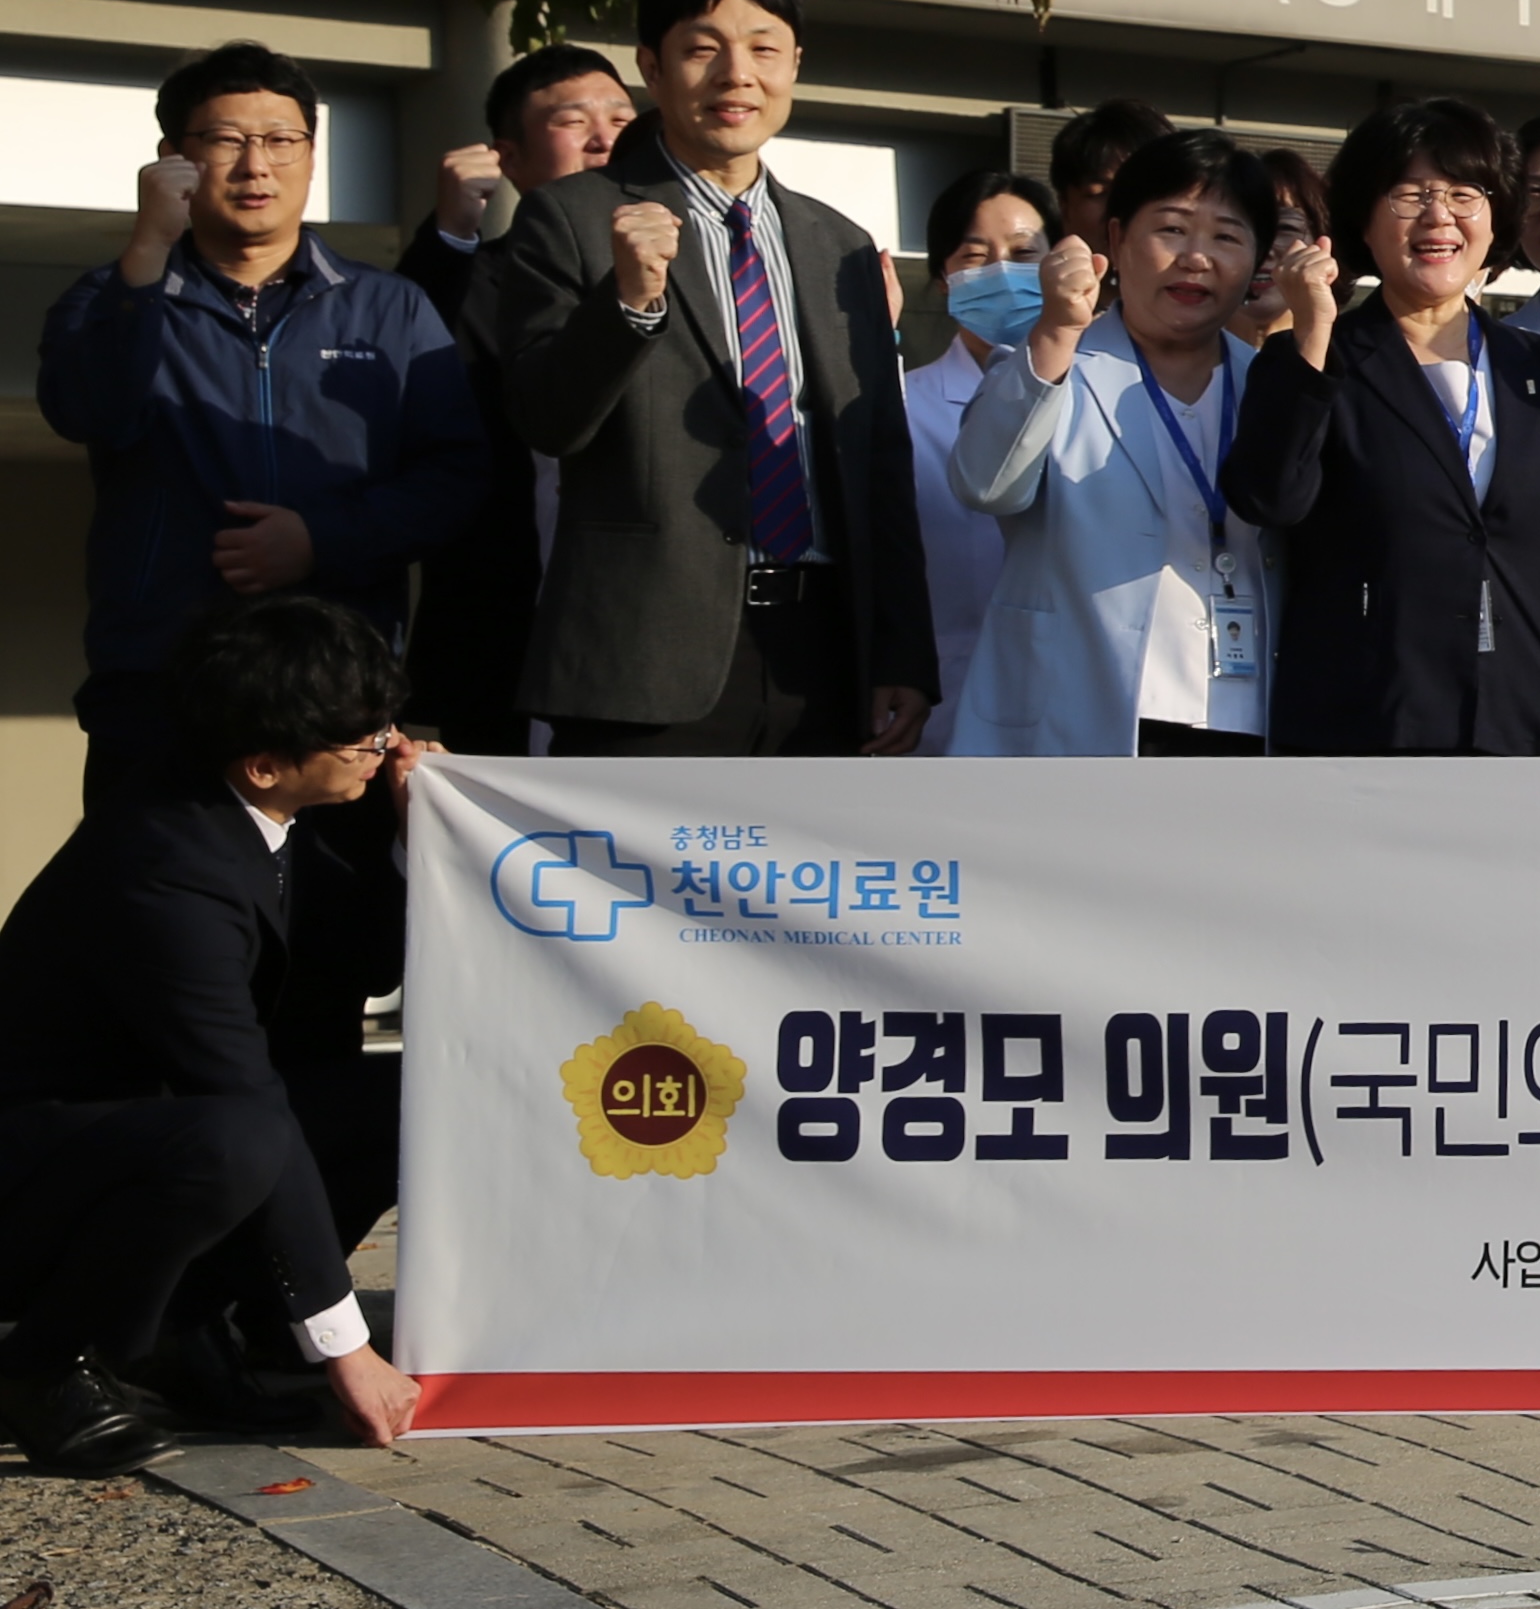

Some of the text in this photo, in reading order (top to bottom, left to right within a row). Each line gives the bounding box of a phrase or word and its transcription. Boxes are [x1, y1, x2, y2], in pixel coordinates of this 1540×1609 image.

[670, 826, 768, 851] 충청남도
[671, 860, 961, 919] 천안의료원
[679, 928, 962, 946] CHEONAN MEDICAL CENTER
[606, 1073, 697, 1119] 의회
[777, 1010, 1070, 1163] 양경모
